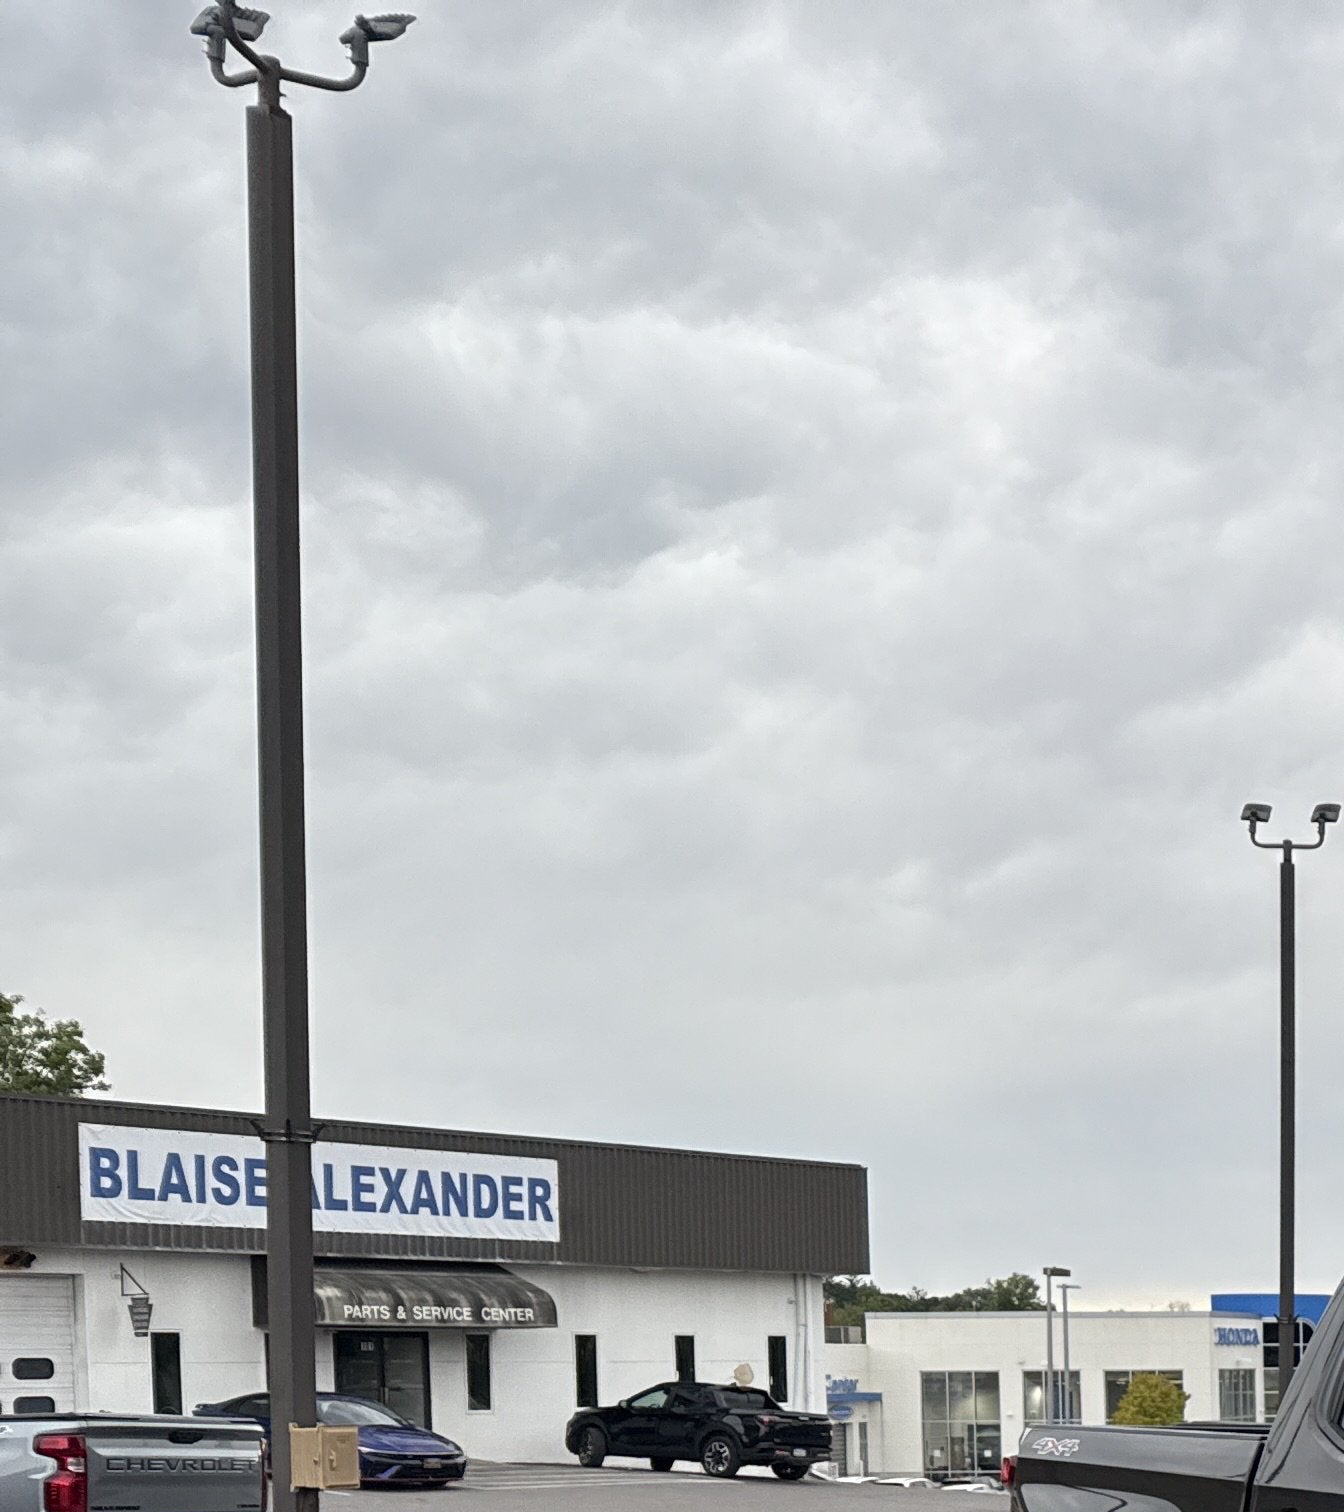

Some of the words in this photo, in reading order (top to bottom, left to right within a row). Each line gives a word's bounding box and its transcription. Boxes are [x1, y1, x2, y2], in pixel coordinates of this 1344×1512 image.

[88, 1146, 268, 1207] BLAISE
[311, 1162, 553, 1222] LEXANDER
[343, 1304, 391, 1320] PARTS
[396, 1305, 407, 1320] &
[413, 1305, 473, 1321] SERVICE
[481, 1306, 535, 1322] CENTER
[1214, 1327, 1261, 1346] HONDA
[105, 1457, 260, 1473] CHEVROLET
